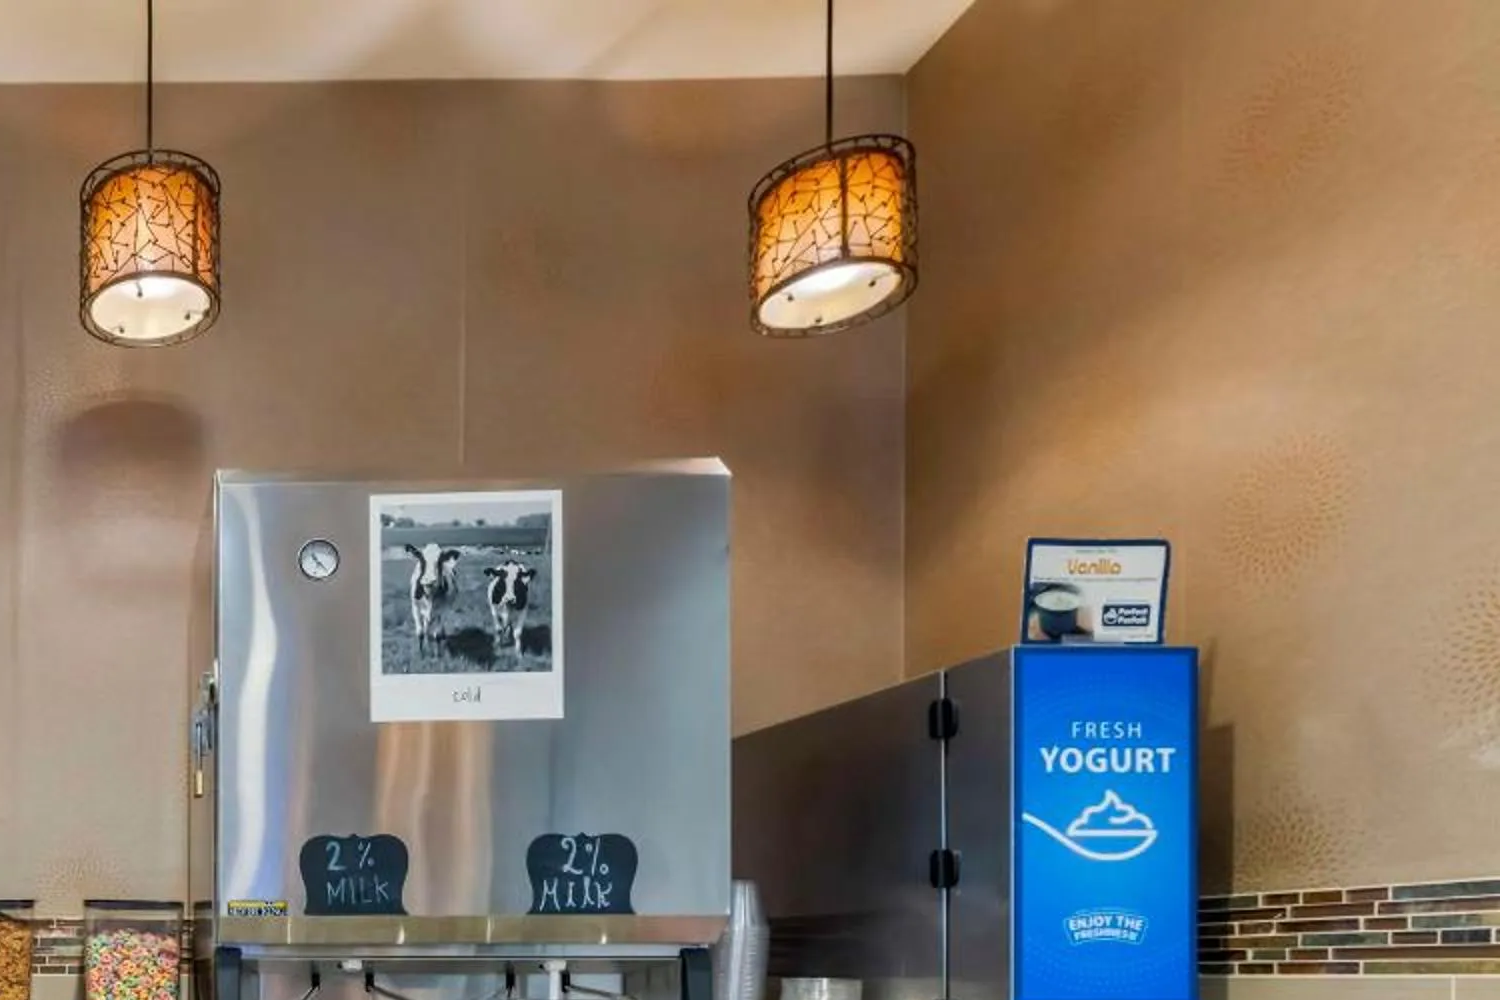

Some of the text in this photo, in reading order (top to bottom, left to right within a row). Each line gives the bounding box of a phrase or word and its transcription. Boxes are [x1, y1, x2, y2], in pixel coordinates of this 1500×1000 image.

[1067, 558, 1123, 575] Vanilla
[452, 685, 481, 703] cold
[1071, 721, 1142, 739] FRESH
[1039, 746, 1176, 774] YOGURT
[560, 837, 609, 876] 2%
[326, 873, 389, 906] MILK
[1068, 914, 1145, 931] ENJOY THE
